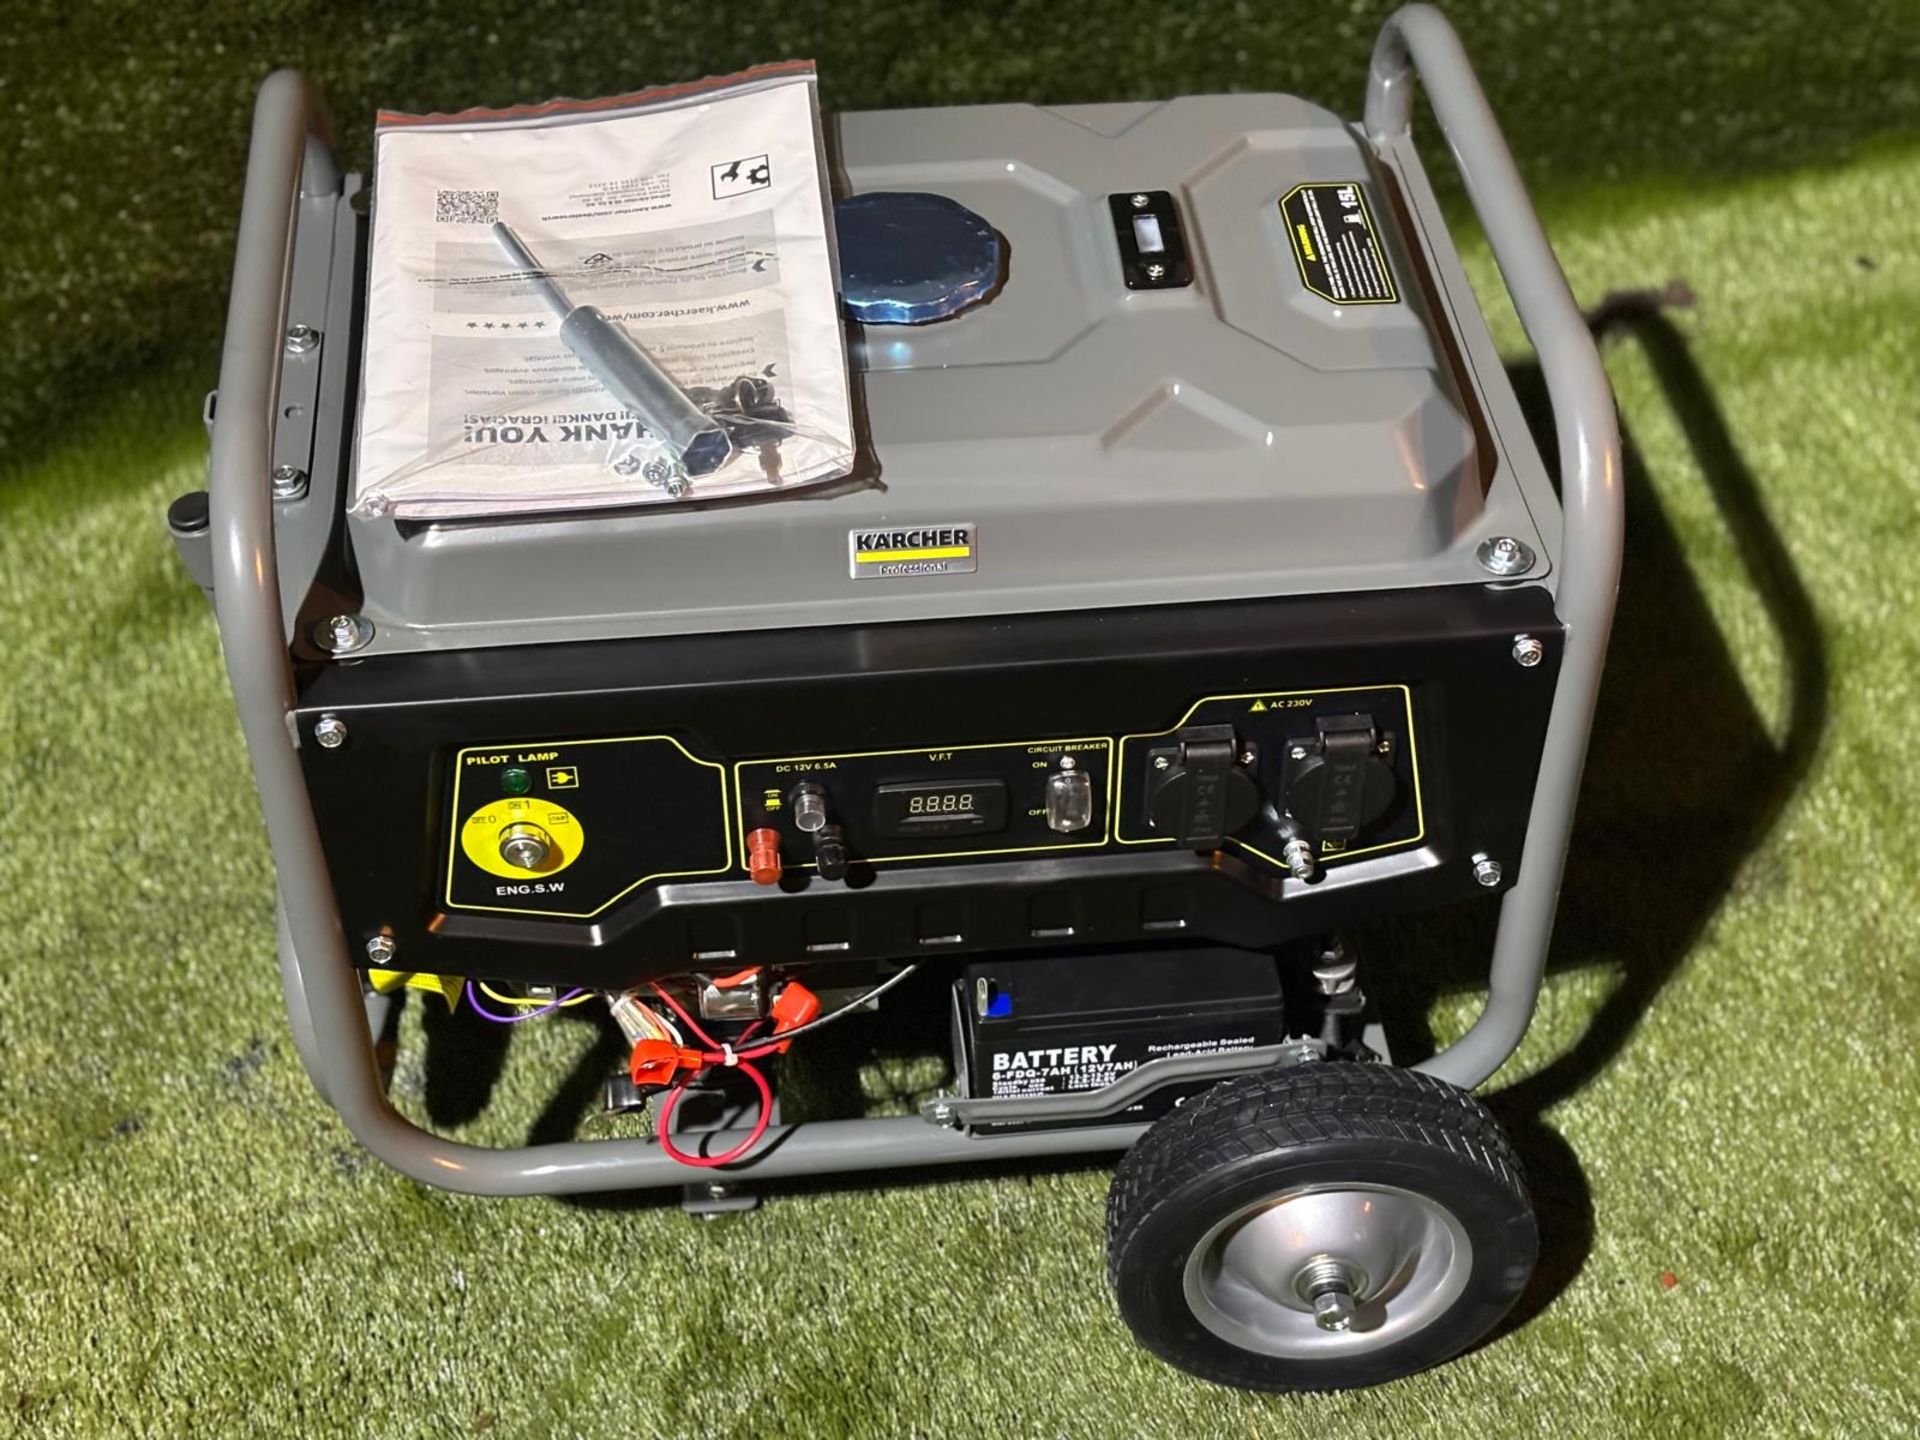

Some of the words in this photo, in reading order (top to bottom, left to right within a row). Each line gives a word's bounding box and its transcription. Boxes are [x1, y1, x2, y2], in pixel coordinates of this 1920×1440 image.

[1336, 185, 1358, 208] 15L
[553, 412, 616, 424] DANKE!
[464, 426, 549, 444] YOU!
[560, 422, 654, 442] HANK
[856, 529, 969, 550] KÄRCHER
[879, 561, 948, 575] Professional
[1270, 701, 1285, 709] AC
[1287, 699, 1313, 708] 230V
[1027, 745, 1063, 754] CIRCUIT
[1065, 743, 1108, 752] BREAKER
[466, 755, 509, 766] PILOT
[518, 752, 559, 763] LAMP
[1032, 761, 1048, 769] ON
[775, 765, 791, 773] DC
[794, 763, 812, 772] 12V
[814, 762, 837, 770] 6.5A
[496, 883, 564, 896] ENG.S.W
[1148, 1040, 1218, 1052] Rechargeable
[1220, 1036, 1255, 1046] Sealed
[993, 1044, 1117, 1071] BATTERY
